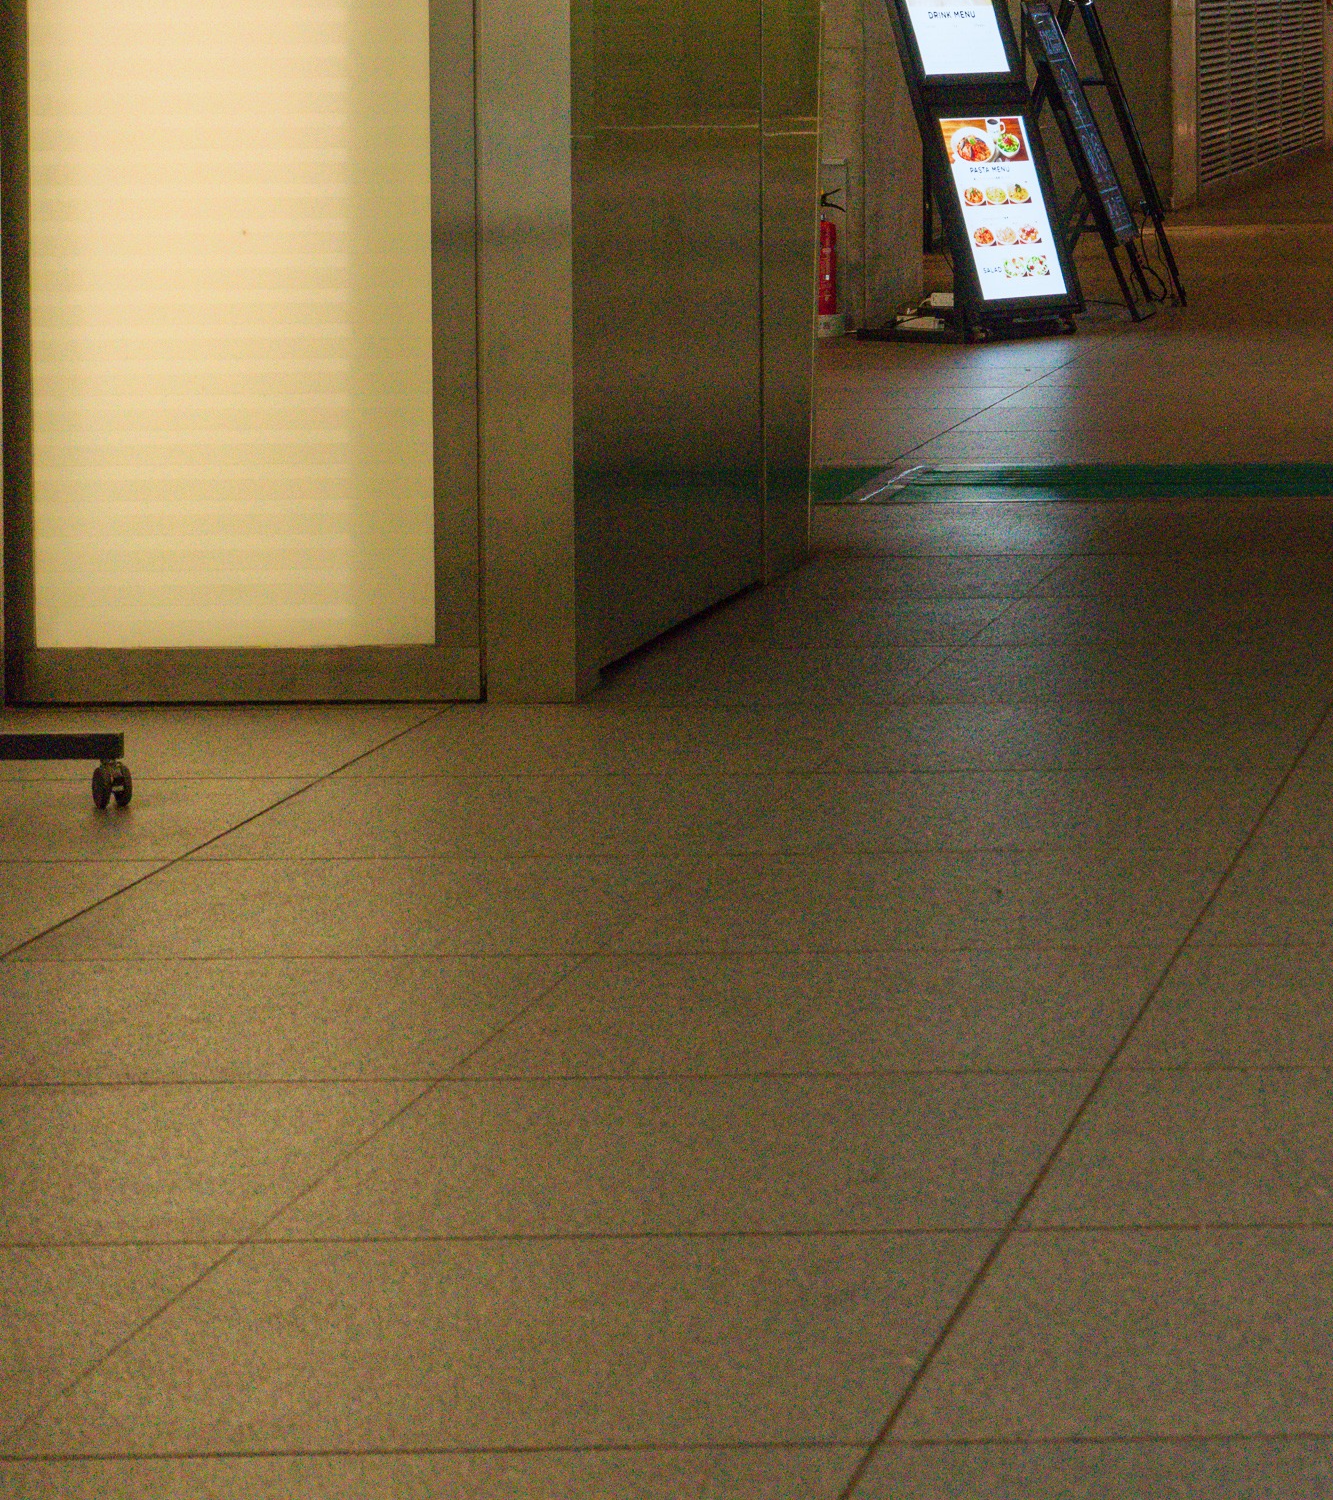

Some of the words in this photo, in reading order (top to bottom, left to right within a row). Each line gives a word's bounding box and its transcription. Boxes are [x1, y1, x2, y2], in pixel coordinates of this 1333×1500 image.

[927, 11, 952, 20] DRINK
[953, 10, 976, 19] MENU
[969, 166, 990, 174] PASTA
[991, 165, 1010, 173] MENU
